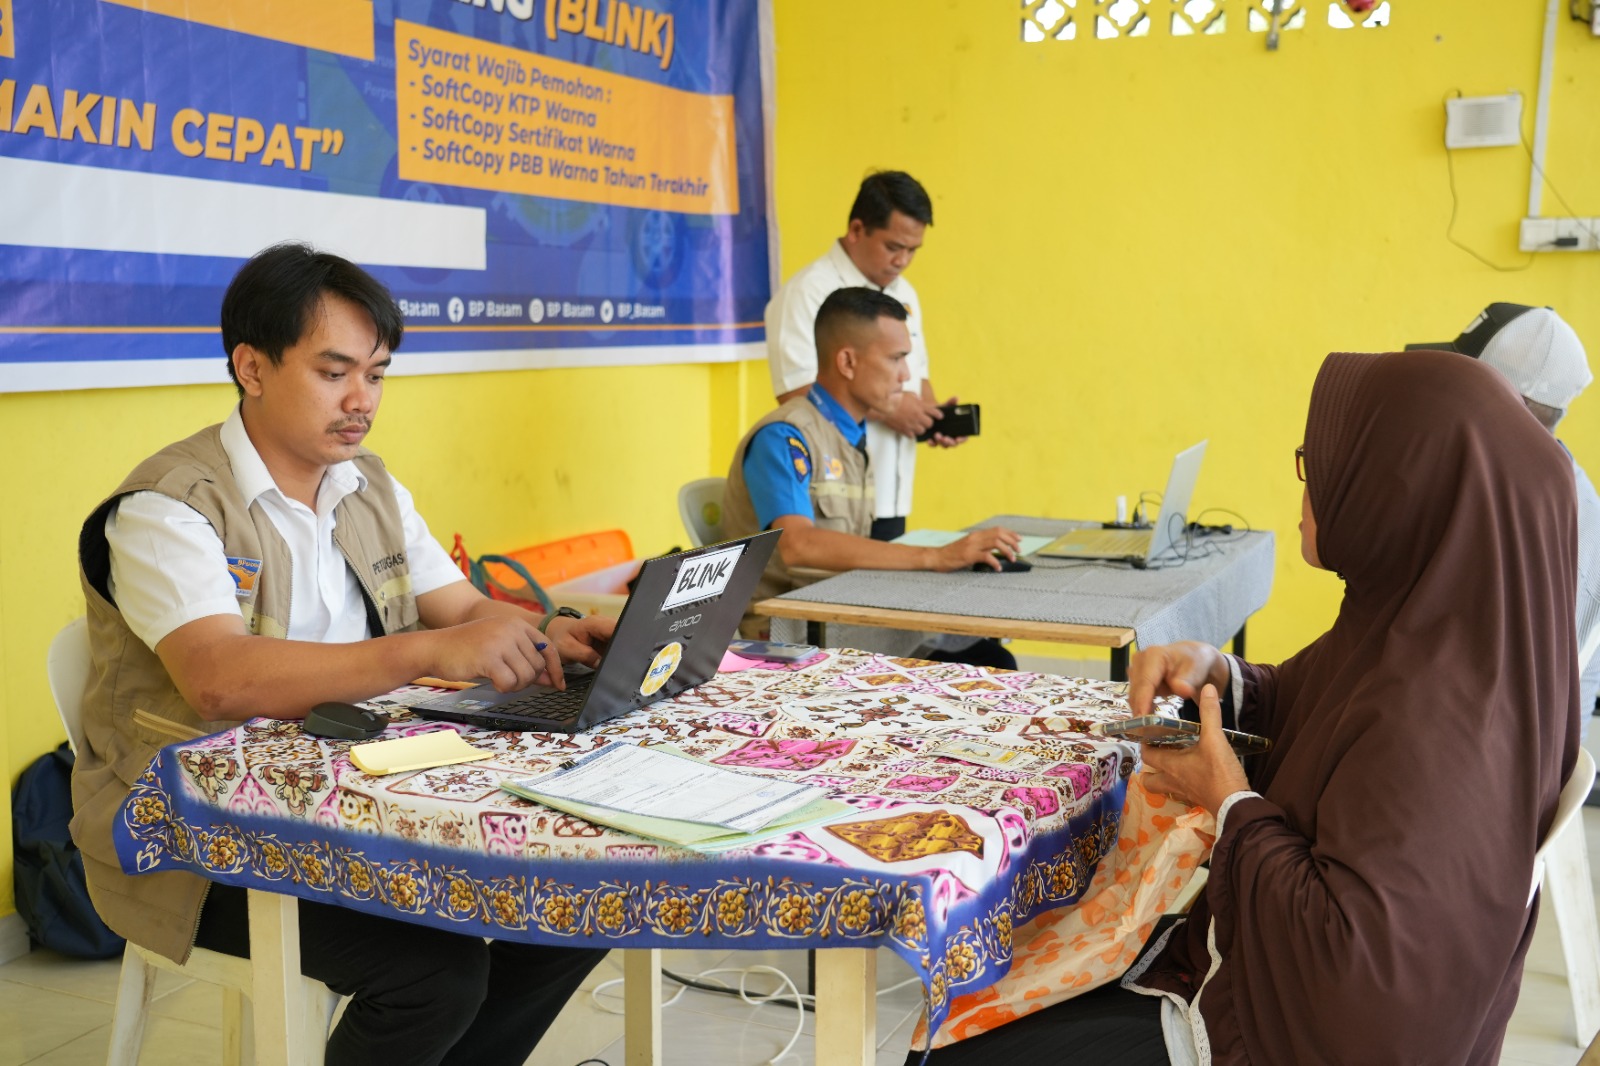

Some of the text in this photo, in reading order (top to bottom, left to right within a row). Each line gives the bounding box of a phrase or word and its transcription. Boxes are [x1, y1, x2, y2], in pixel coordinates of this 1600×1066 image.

[545, 0, 674, 71] (BLINK)
[408, 38, 471, 73] Syarat
[477, 54, 527, 87] Wajib
[530, 67, 604, 103] Pemohon
[422, 74, 504, 115] SoftCopy
[508, 92, 541, 117] KTP
[546, 99, 597, 128] Warna
[422, 105, 505, 145] SoftCopy
[508, 121, 583, 154] Sertifikat
[588, 136, 636, 161] Warna
[423, 138, 505, 175] SoftCopy
[509, 151, 544, 175] PBB
[549, 157, 599, 183] Warna
[604, 166, 646, 189] Tahun
[650, 172, 709, 196] Terakhir
[399, 299, 440, 318] Batam
[468, 300, 523, 318] BP Batam
[676, 556, 732, 594] BLINK
